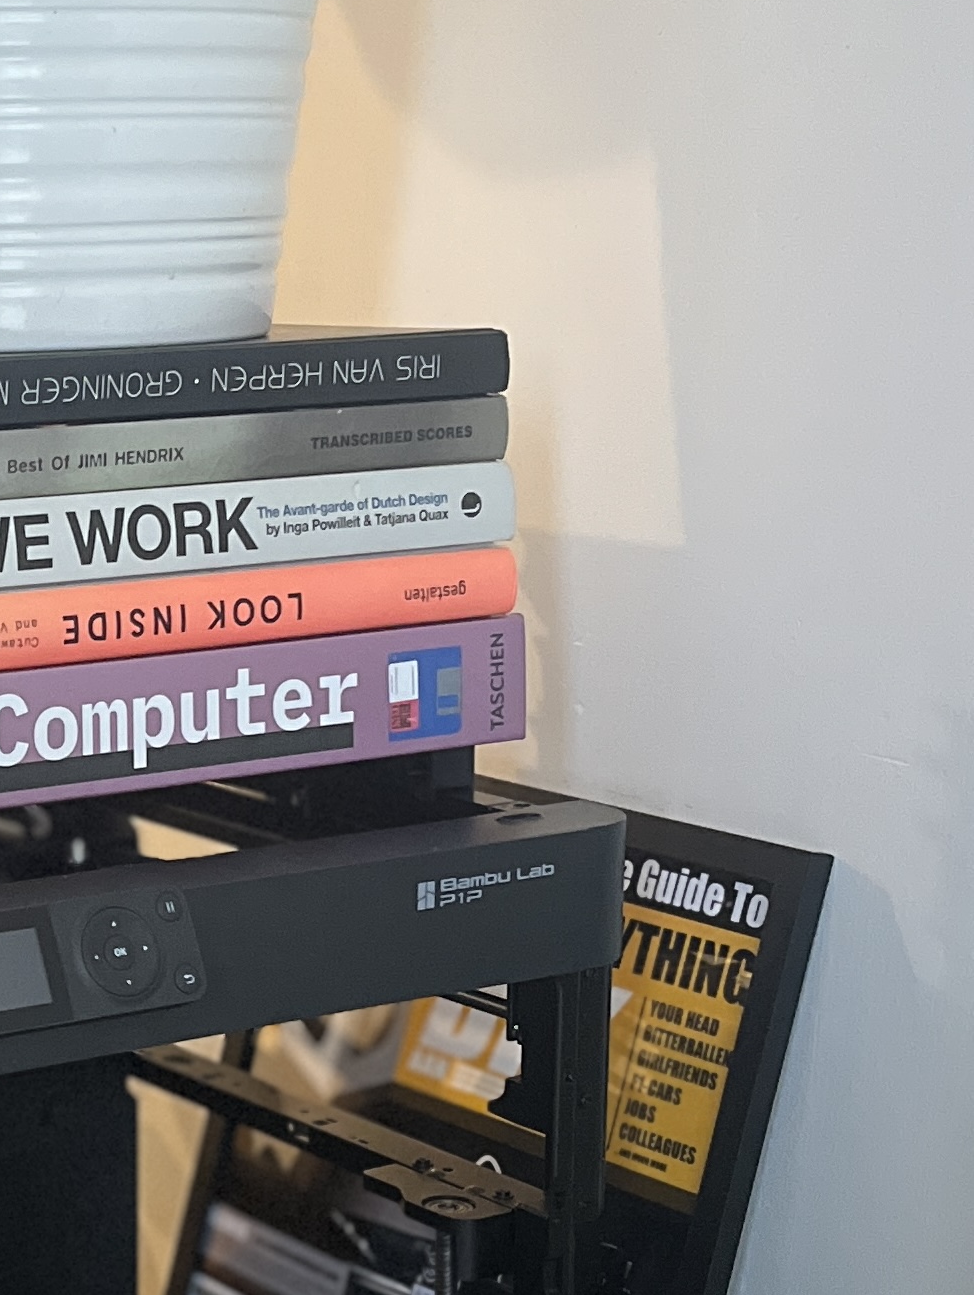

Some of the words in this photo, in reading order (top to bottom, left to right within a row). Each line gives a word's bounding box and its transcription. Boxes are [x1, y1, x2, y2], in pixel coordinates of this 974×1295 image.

[211, 361, 324, 393] HERPEN
[332, 358, 385, 385] VAN
[395, 353, 442, 382] IRIS
[21, 370, 183, 405] GRONINGER
[310, 429, 413, 451] TRANSCRIBED
[417, 424, 474, 442] SCORES
[7, 458, 44, 475] Best
[51, 456, 71, 471] Of
[77, 452, 108, 469] JIMI
[114, 446, 185, 467] HENDRIX
[256, 506, 280, 520] The
[282, 499, 354, 517] Avant-garde
[357, 497, 369, 511] of
[372, 494, 406, 509] Dutch
[409, 491, 448, 507] Design
[65, 496, 259, 566] WORK
[266, 523, 280, 538] by
[283, 520, 309, 536] Inga
[364, 514, 372, 526] &
[375, 511, 416, 527] Tatjana
[419, 508, 449, 522] Quax
[404, 580, 467, 603] gestalten
[15, 619, 38, 631] and
[62, 603, 187, 645] INSIDE
[207, 592, 304, 631] LOOK
[489, 632, 505, 732] TASCHEN
[440, 870, 511, 893] Bambu
[516, 863, 555, 881] Lab
[636, 858, 726, 918] Guide
[730, 880, 770, 929] To
[649, 999, 684, 1026] YOUR
[684, 1010, 720, 1037] HEAD
[618, 1121, 697, 1166] COLLEAGUES
